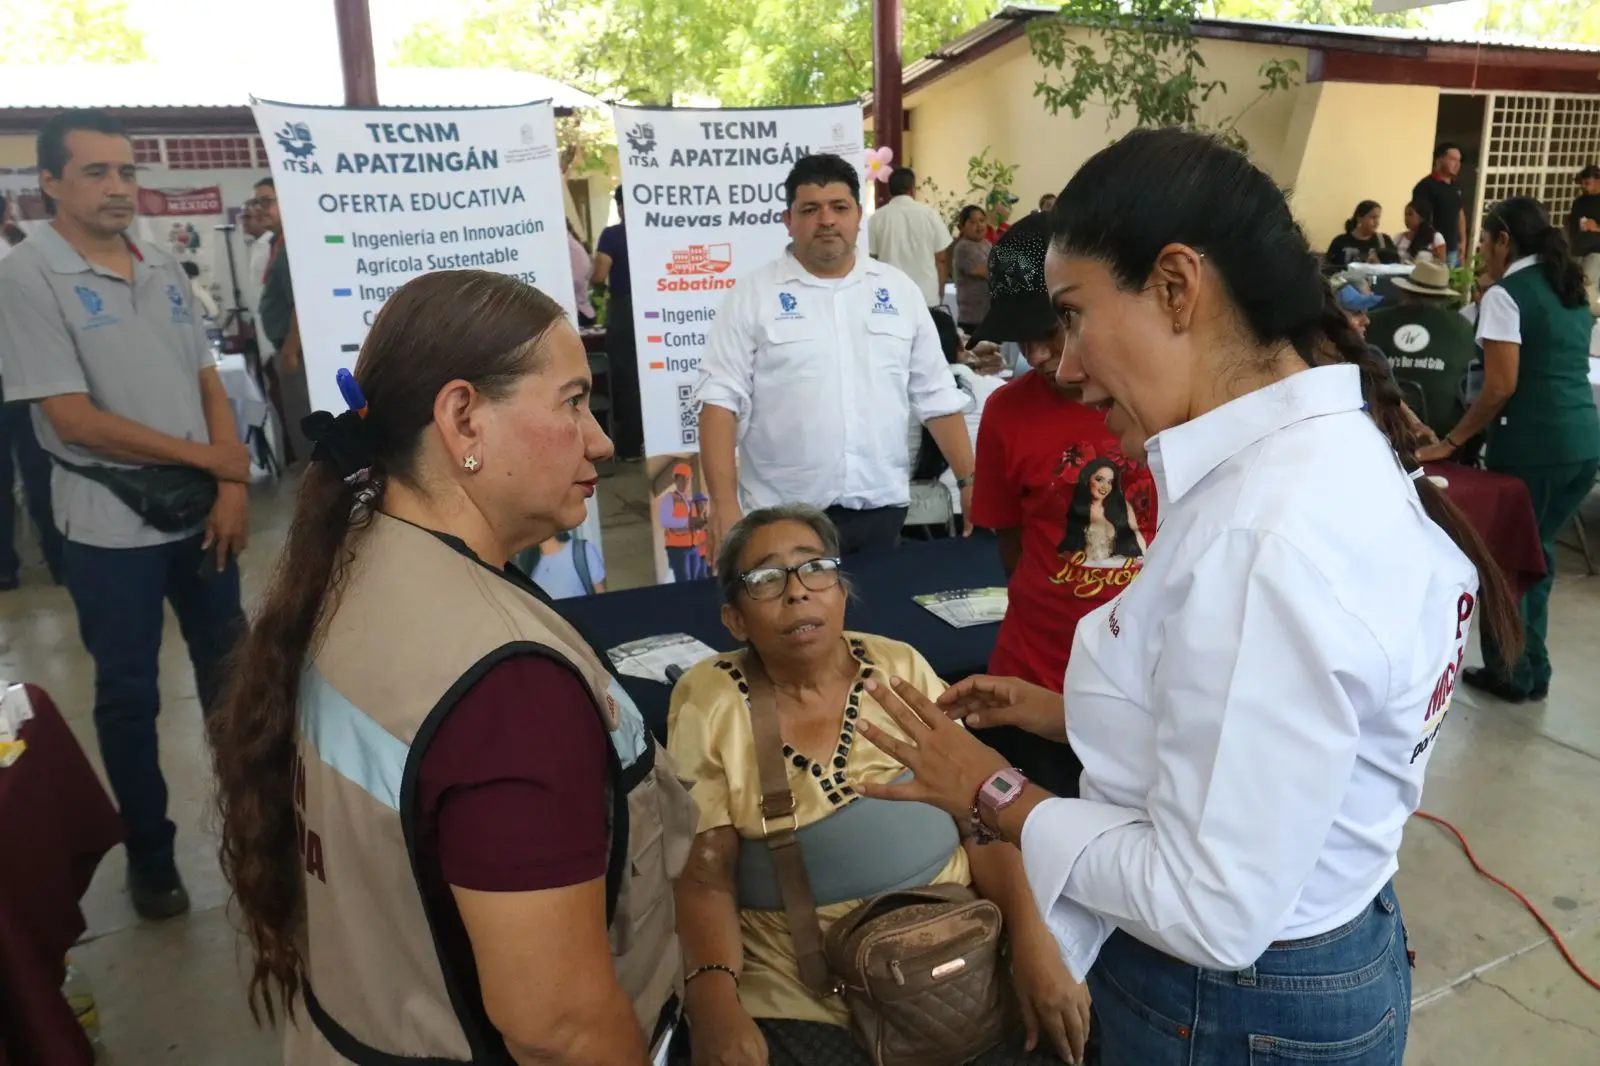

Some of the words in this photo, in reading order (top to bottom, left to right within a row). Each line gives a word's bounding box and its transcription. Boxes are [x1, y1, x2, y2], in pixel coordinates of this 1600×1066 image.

[366, 122, 459, 143] TECNM
[700, 121, 777, 140] TECNM
[282, 159, 322, 174] ITSA
[335, 147, 498, 174] APATZINGÁN
[629, 156, 659, 168] ITSA
[318, 193, 404, 213] OFERTA
[411, 185, 526, 211] EDUCATIVA
[633, 183, 719, 205] OFERTA
[729, 182, 788, 204] EDUC
[645, 211, 722, 228] Nuevas
[729, 209, 783, 226] Moda
[439, 231, 459, 243] en
[463, 218, 544, 241] Innovación
[427, 248, 519, 270] Sustentable
[359, 284, 398, 301] Inge
[662, 306, 716, 325] Ingenie
[664, 332, 707, 347] Conta
